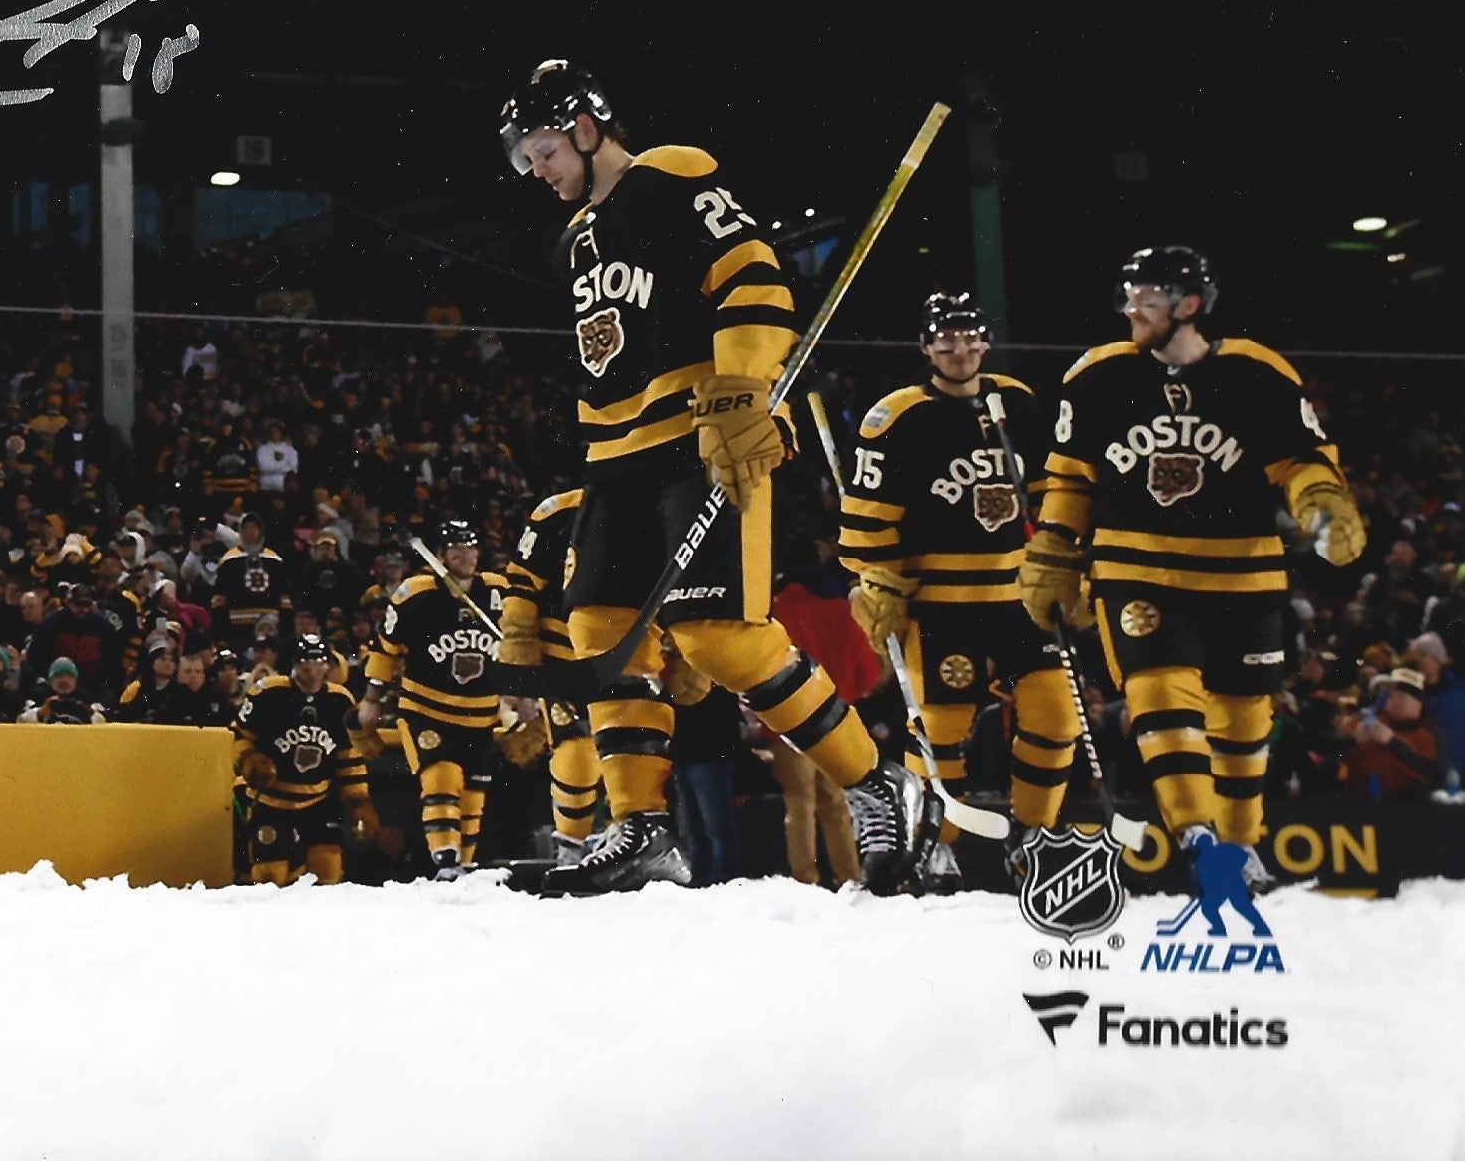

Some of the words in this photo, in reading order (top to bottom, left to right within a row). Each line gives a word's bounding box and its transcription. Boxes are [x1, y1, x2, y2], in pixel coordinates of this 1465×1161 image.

[572, 261, 654, 313] STON
[852, 446, 885, 490] 15
[1105, 415, 1244, 474] BOSTON
[930, 448, 1025, 506] BOST
[674, 481, 727, 570] BAUE
[274, 725, 337, 755] BOSTON
